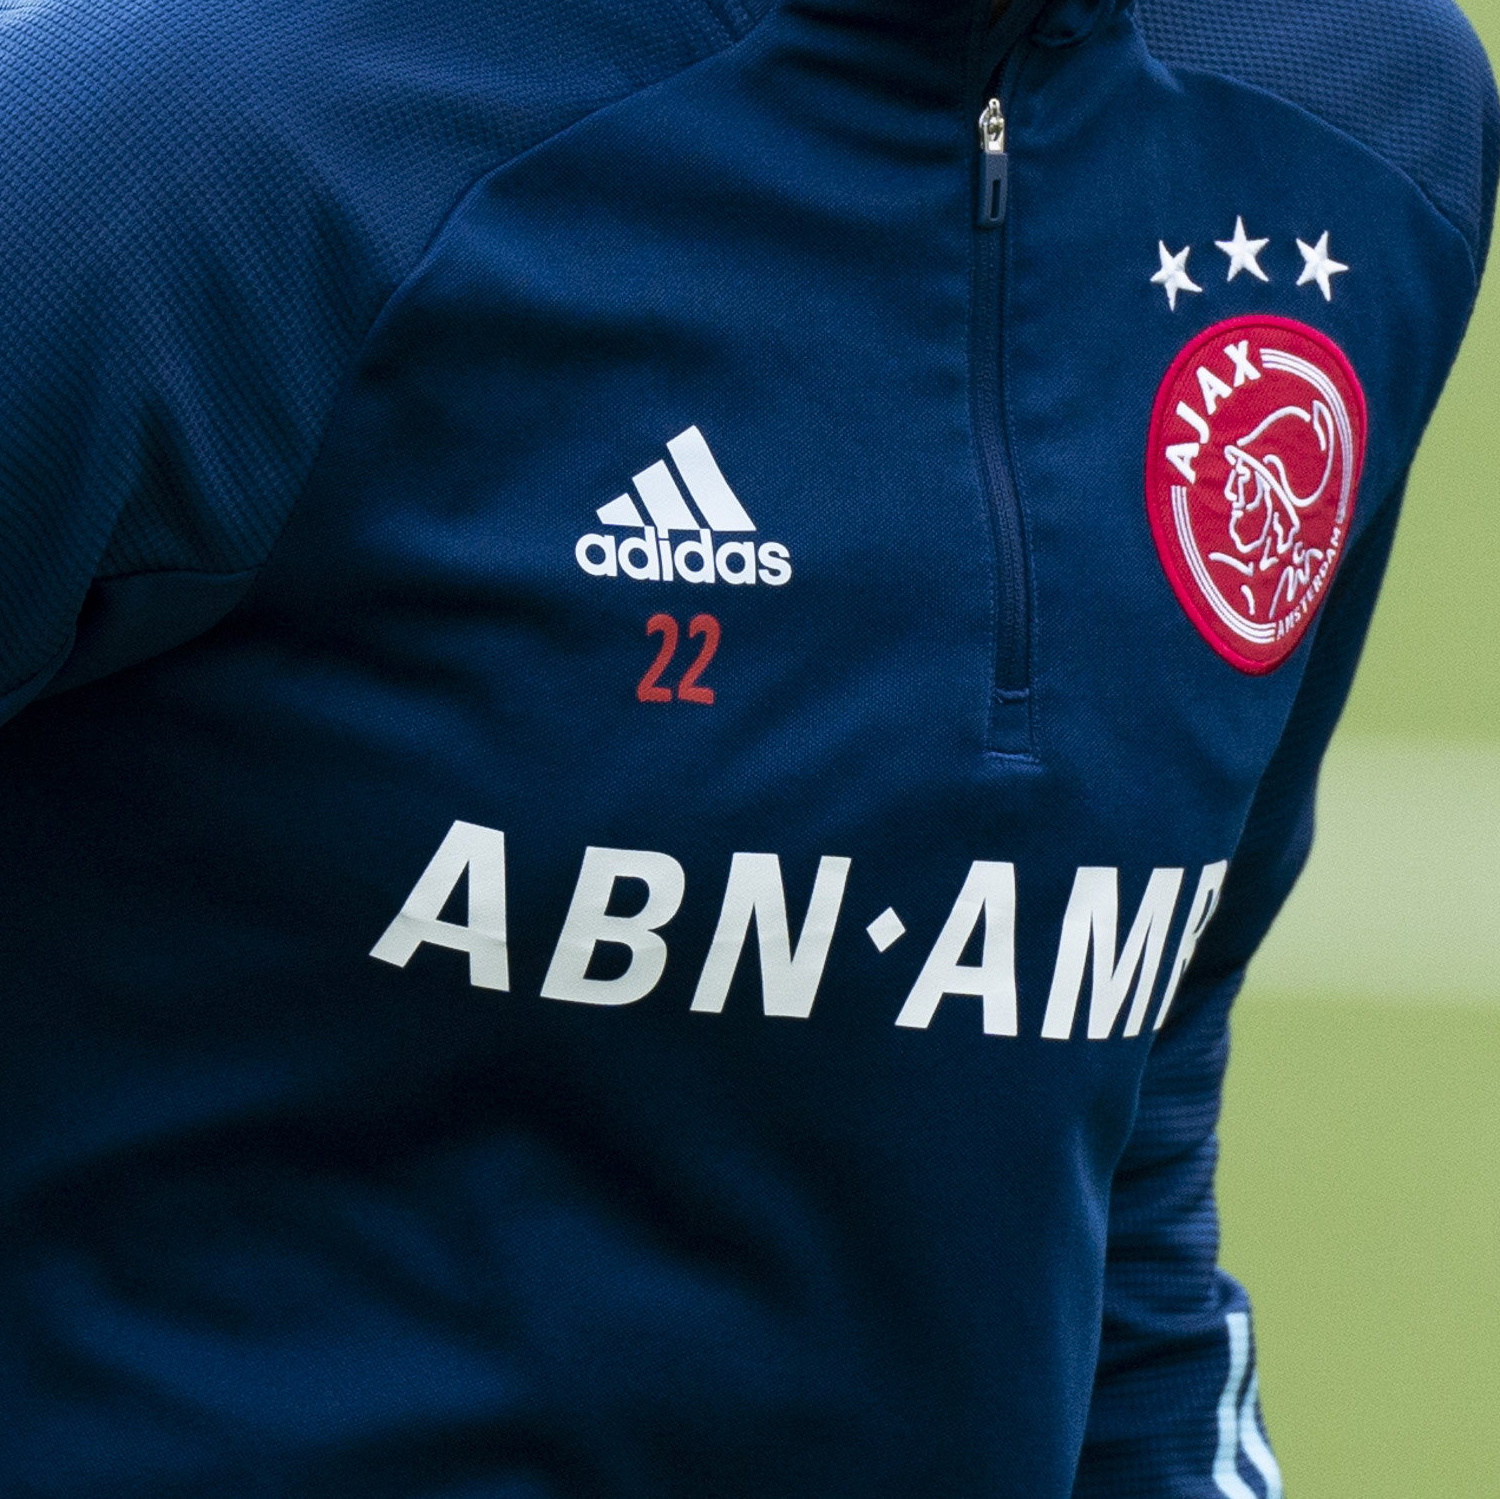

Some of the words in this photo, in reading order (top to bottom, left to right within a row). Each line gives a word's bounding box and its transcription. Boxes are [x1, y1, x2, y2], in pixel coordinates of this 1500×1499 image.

[1165, 339, 1262, 485] AJAX
[574, 525, 793, 586] adidas
[636, 612, 721, 705] 22
